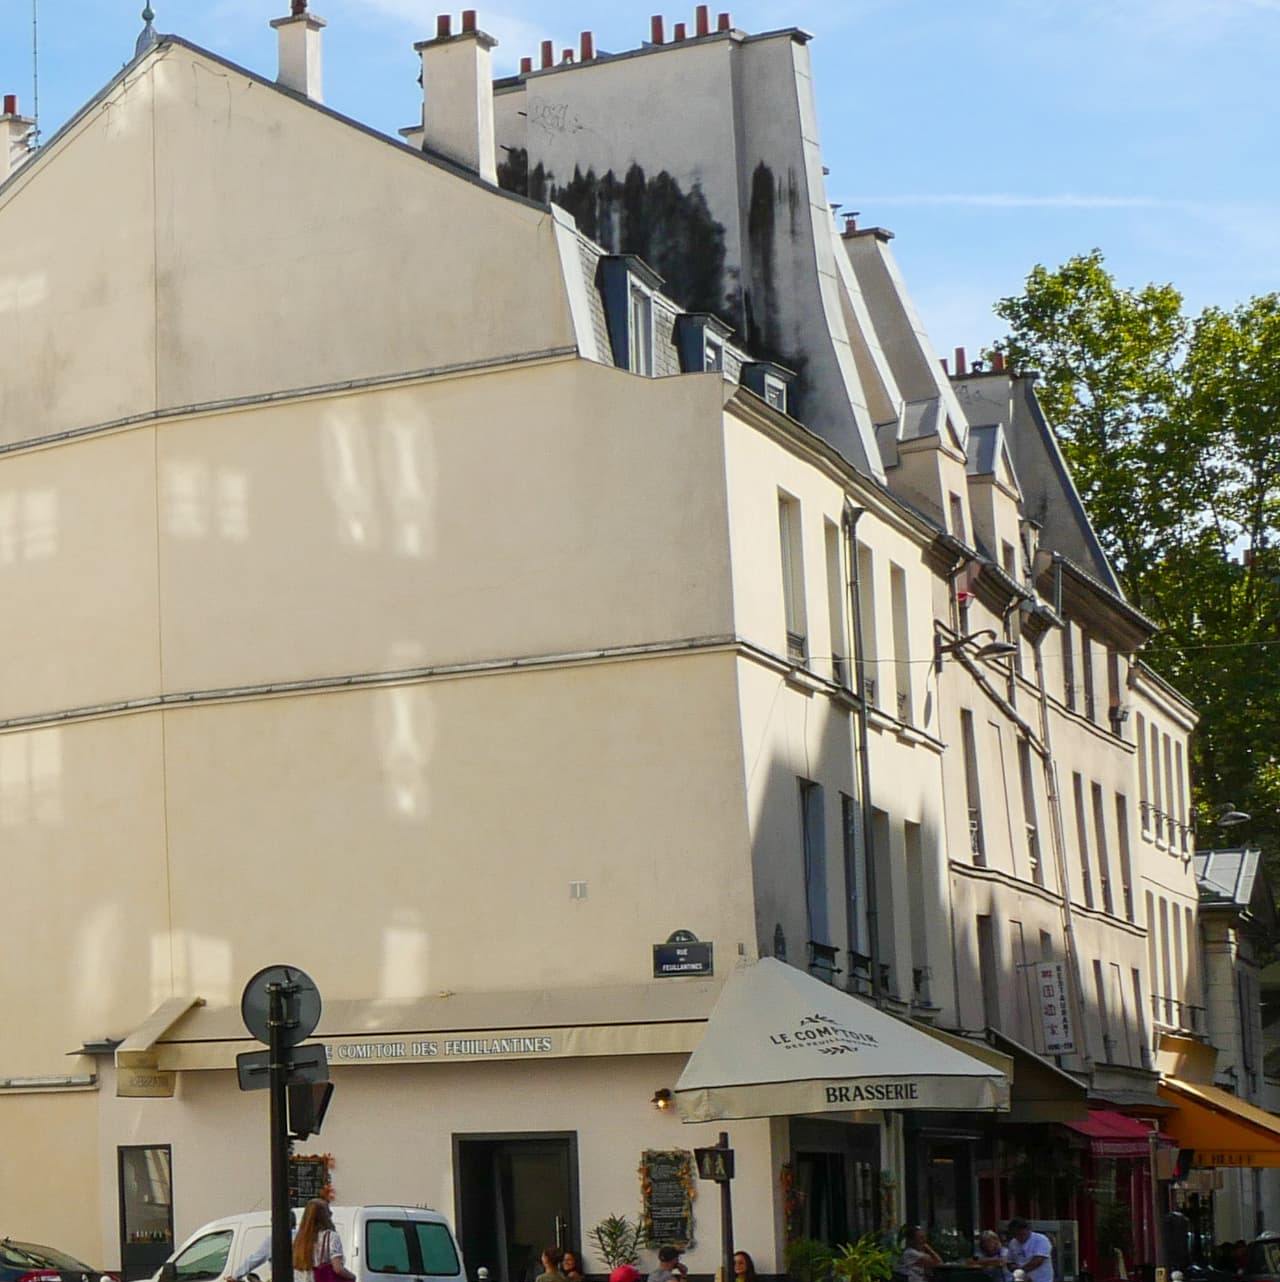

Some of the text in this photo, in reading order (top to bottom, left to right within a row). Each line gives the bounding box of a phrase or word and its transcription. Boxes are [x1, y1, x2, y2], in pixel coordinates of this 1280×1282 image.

[769, 1026, 879, 1045] LE COMPTOIR
[338, 1042, 406, 1059] COMPTOIR
[411, 1041, 438, 1057] DES
[444, 1036, 552, 1055] FEUILLANTINES
[825, 1083, 918, 1103] BRASSERIE
